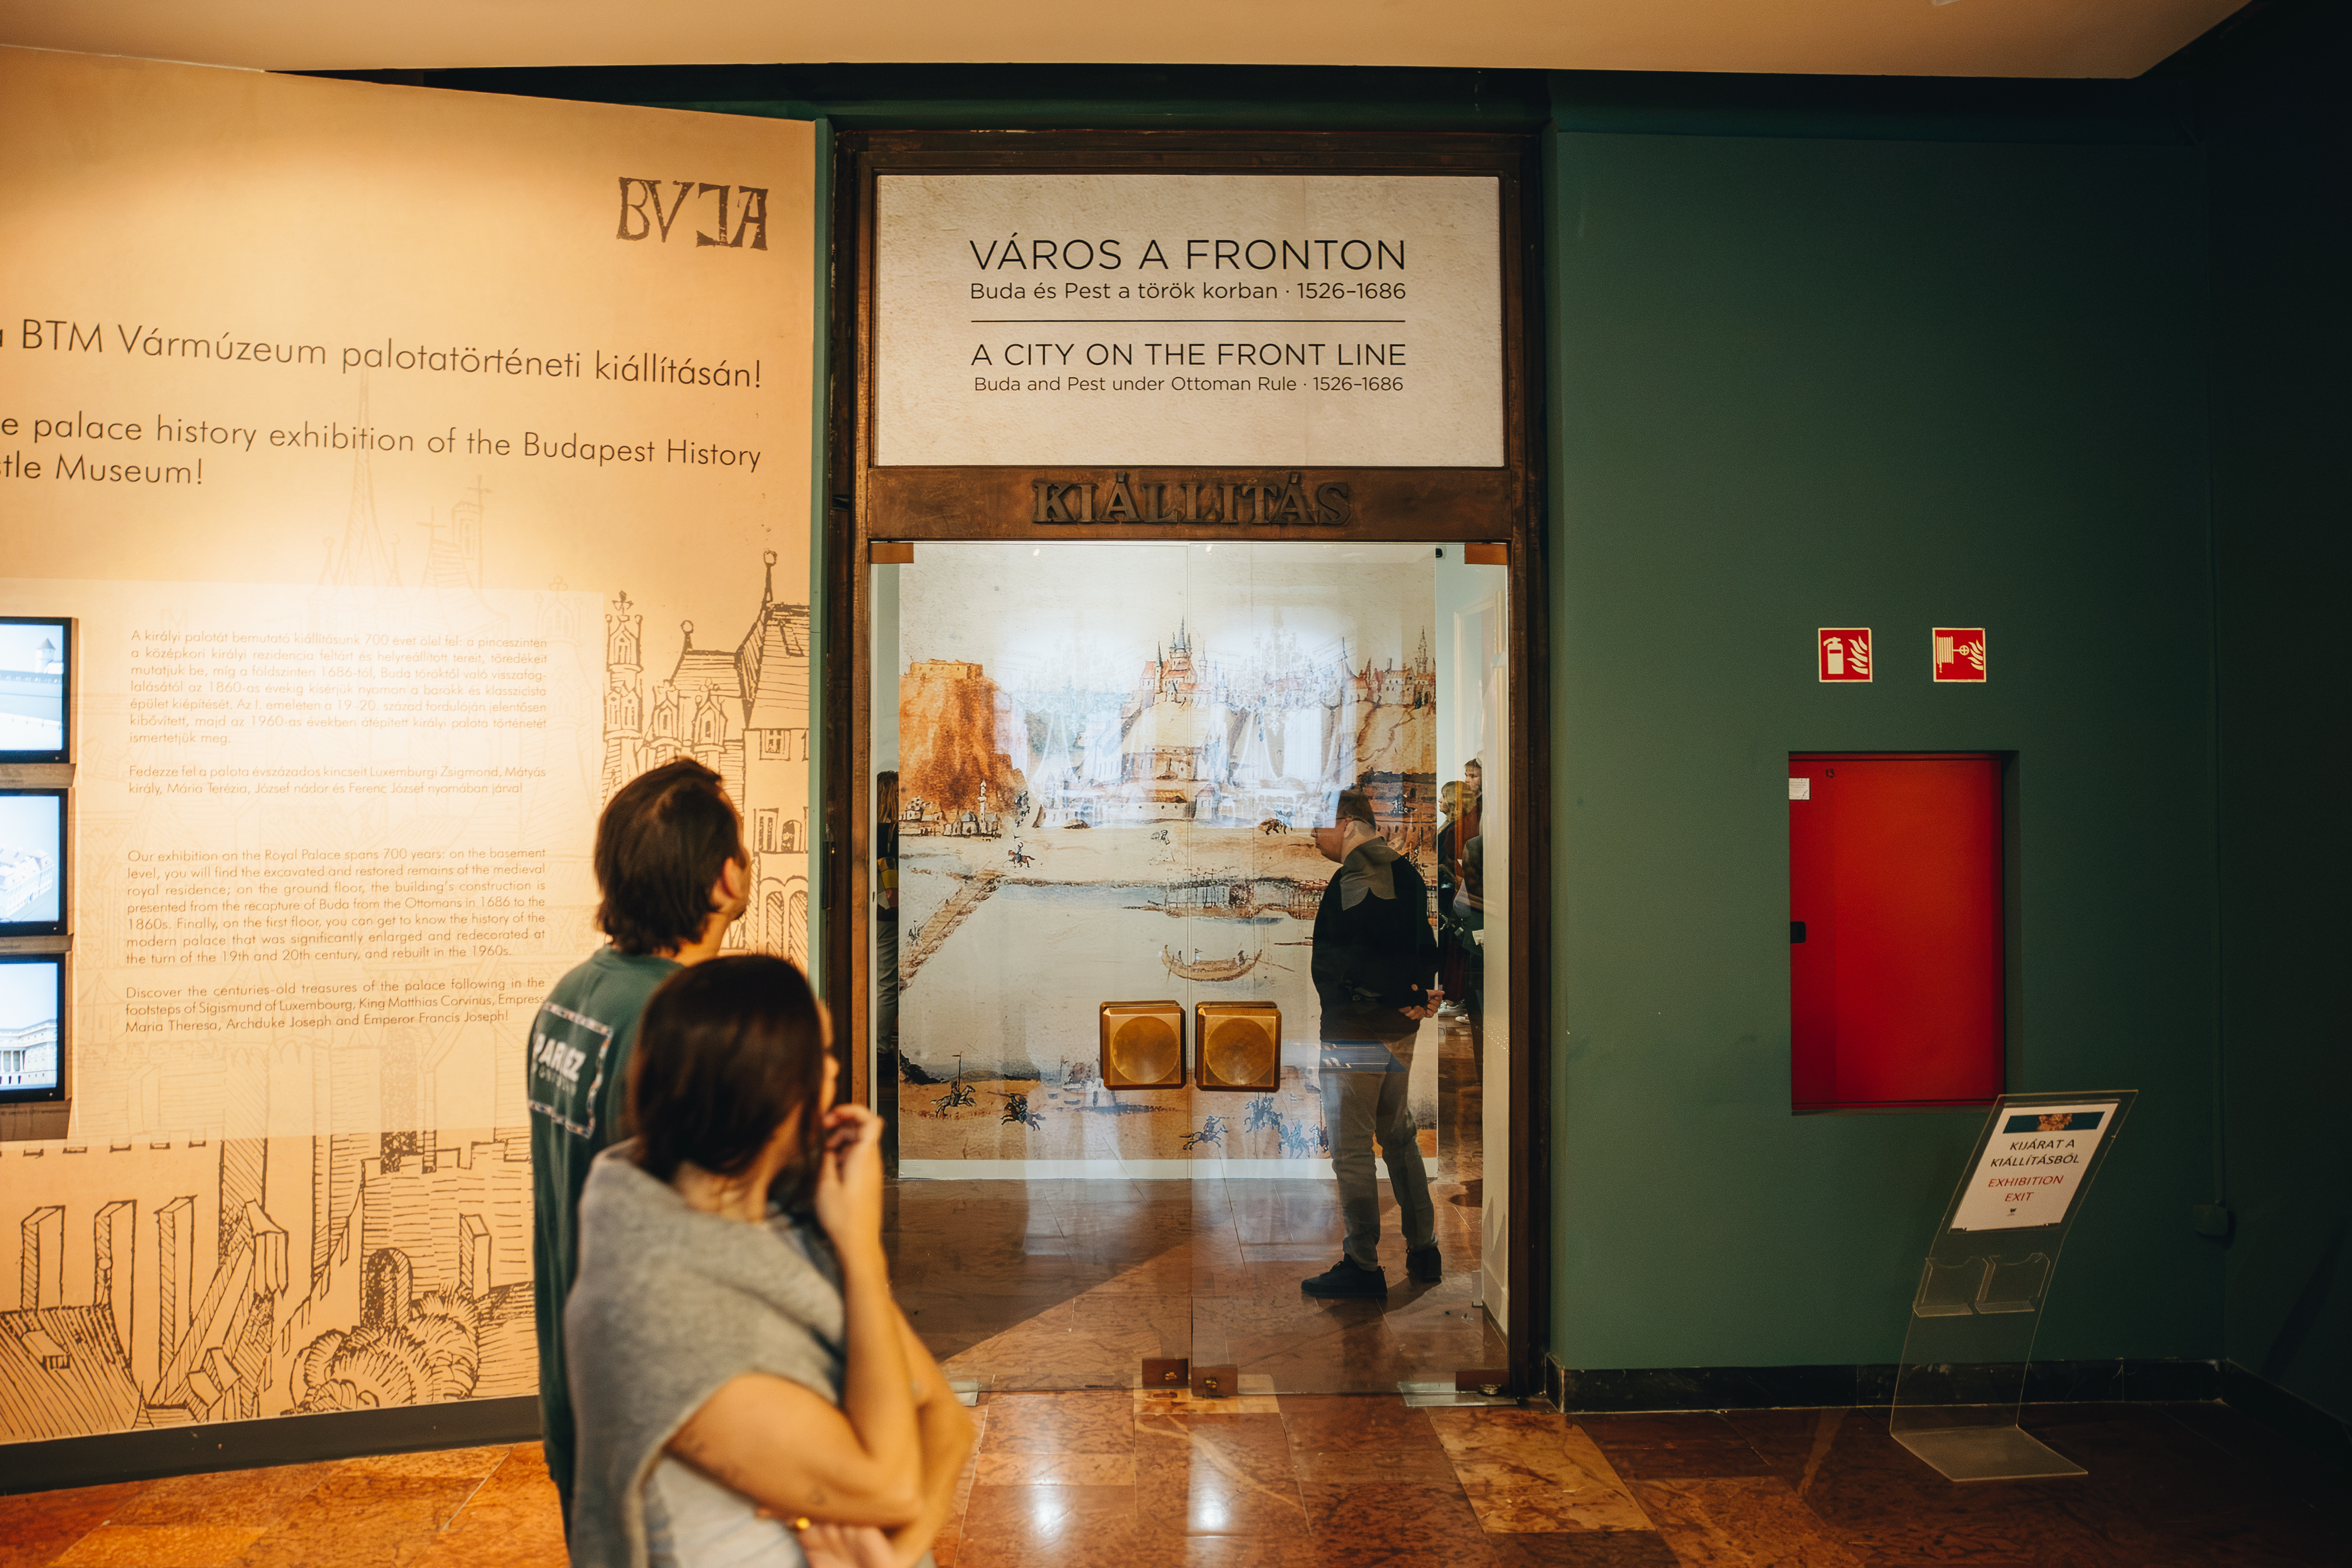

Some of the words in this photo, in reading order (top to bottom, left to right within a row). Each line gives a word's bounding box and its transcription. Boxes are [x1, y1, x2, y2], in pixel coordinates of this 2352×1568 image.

[970, 232, 1121, 270] VÁROS
[1139, 239, 1168, 269] A
[1187, 239, 1404, 270] FRONTON
[971, 283, 1025, 299] Buda
[1034, 282, 1056, 299] és
[1065, 283, 1110, 299] Pest
[1118, 286, 1130, 299] a
[1138, 282, 1195, 299] török
[1204, 282, 1277, 299] korban
[22, 319, 103, 353] BTM
[118, 324, 326, 365] Vármúzeum
[343, 337, 580, 377] palotatörténeti
[596, 350, 760, 388] kiállításán!
[971, 344, 992, 366] A
[1005, 344, 1074, 366] CITY
[1087, 343, 1132, 365] ON
[1145, 343, 1205, 365] THE
[1218, 343, 1325, 365] FRONT
[1338, 344, 1406, 365] LINE
[975, 377, 1020, 391] Buda
[1027, 376, 1060, 391] and
[1068, 377, 1105, 390] Pest
[1113, 376, 1164, 390] under
[1171, 377, 1251, 390] Ottoman
[1259, 376, 1297, 390] Rule
[34, 410, 142, 444] palace
[157, 414, 257, 452] history
[270, 420, 413, 452] exhibition
[427, 427, 456, 453] of
[466, 428, 510, 456] the
[524, 432, 656, 467] Budapest
[668, 439, 761, 473] History
[0, 450, 41, 479] tle
[56, 453, 202, 484] Museum!
[131, 630, 141, 640] A
[145, 630, 181, 644] királyi
[185, 631, 228, 644] palotát
[233, 631, 290, 643] bemutató
[366, 634, 389, 645] 700
[393, 636, 416, 646] évet
[420, 635, 441, 646] ölel
[445, 635, 462, 646] fel:
[478, 639, 547, 648] pinceszinten
[130, 765, 178, 777] Fedezze
[182, 765, 196, 776] fel
[211, 765, 249, 778] palota
[252, 765, 320, 777] évszázados
[323, 765, 368, 777] kincseit
[370, 765, 437, 780] Luxemburgi
[440, 765, 502, 779] Zsigmond,
[505, 767, 546, 779] Mátyás
[129, 782, 162, 796] király,
[168, 783, 202, 793] Mária
[207, 782, 250, 795] Terézia,
[255, 782, 290, 793] József
[295, 782, 329, 793] nádor
[333, 783, 345, 793] és
[349, 782, 386, 794] Ferenc
[391, 782, 424, 794] József
[428, 783, 488, 795] nyomában
[492, 783, 523, 795] járva!
[128, 850, 155, 861] Our
[158, 850, 218, 861] exhibition
[242, 850, 261, 860] the
[265, 848, 297, 862] Royal
[302, 849, 340, 860] Palace
[345, 852, 379, 862] spans
[384, 848, 407, 859] 700
[411, 851, 445, 861] years:
[468, 847, 486, 858] the
[490, 847, 546, 858] basement
[128, 867, 160, 880] level,
[165, 871, 186, 881] you
[191, 866, 210, 878] will
[215, 866, 238, 877] find
[242, 866, 260, 877] the
[264, 865, 325, 877] excavated
[328, 865, 351, 876] and
[356, 864, 403, 876] restored
[457, 864, 469, 875] of
[472, 864, 489, 874] the
[494, 863, 545, 874] medieval
[127, 935, 176, 947] modern
[183, 934, 226, 948] palace
[232, 934, 256, 945] that
[291, 931, 363, 946] significantly
[369, 930, 422, 944] enlarged
[428, 929, 451, 941] and
[457, 928, 529, 940] redecorated
[534, 930, 545, 939] at
[126, 952, 146, 964] the
[152, 954, 175, 964] turn
[181, 951, 192, 962] of
[198, 951, 216, 962] the
[223, 950, 249, 961] 19th
[254, 950, 278, 961] and
[283, 949, 310, 961] 20th
[315, 950, 360, 961] century,
[365, 947, 387, 959] and
[393, 946, 429, 958] rebuilt
[435, 948, 444, 957] in
[449, 945, 466, 957] the
[473, 945, 512, 956] 1960s.
[127, 987, 182, 998] Discover
[188, 985, 207, 996] the
[213, 982, 296, 997] centuries-old
[302, 984, 357, 993] treasures
[363, 980, 376, 992] of
[381, 980, 399, 991] the
[405, 979, 445, 993] palace
[452, 978, 505, 991] following
[512, 978, 522, 988] in
[527, 977, 544, 987] the
[126, 1004, 181, 1017] footsteps
[184, 1001, 196, 1014] of
[199, 1000, 262, 1016] Sigismund
[265, 999, 277, 1011] of
[279, 999, 355, 1012] Luxembourg,
[359, 998, 385, 1011] King
[388, 996, 437, 1008] Matthias
[441, 995, 495, 1006] Corvinus,
[499, 994, 544, 1007] Empress
[126, 1021, 163, 1032] Maria
[169, 1019, 221, 1031] Theresa,
[226, 1017, 285, 1029] Archduke
[290, 1015, 331, 1029] Joseph
[336, 1014, 359, 1025] and
[364, 1014, 415, 1027] Emperor
[419, 1012, 460, 1023] Francis
[464, 1010, 508, 1024] Joseph!
[2010, 1139, 2064, 1151] KIJÁRAT
[2065, 1139, 2075, 1148] A
[1990, 1153, 2079, 1167] KIÁLLÍTÁSBÓL
[1988, 1175, 2064, 1188] EXHIBITION
[2004, 1192, 2034, 1202] EXIT
